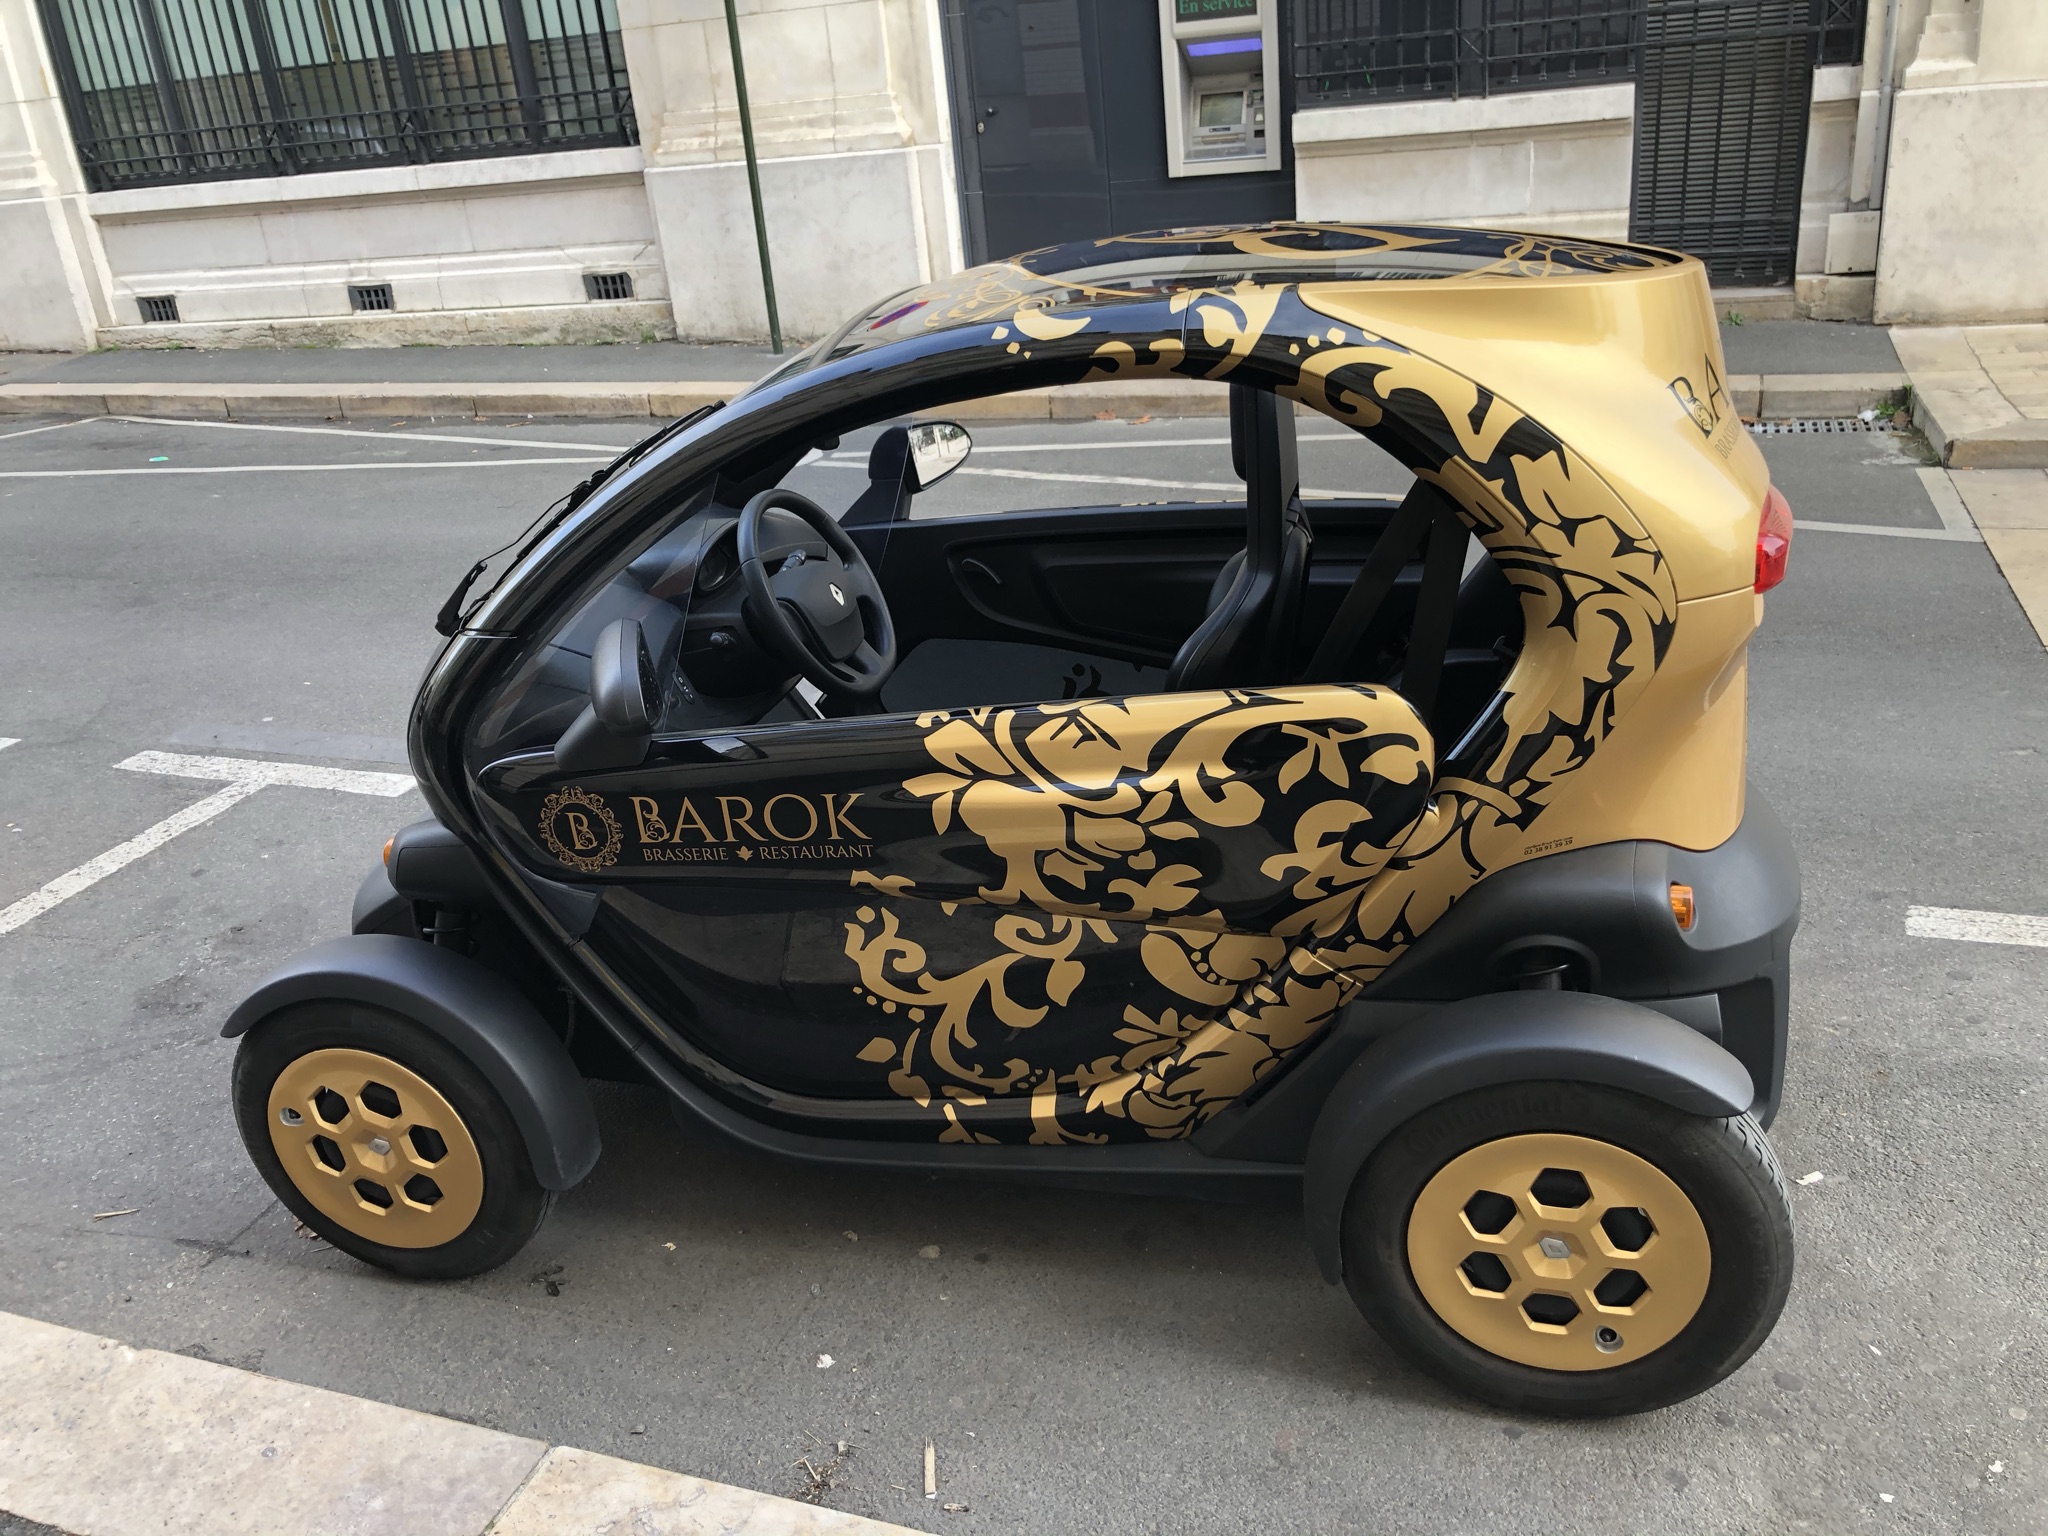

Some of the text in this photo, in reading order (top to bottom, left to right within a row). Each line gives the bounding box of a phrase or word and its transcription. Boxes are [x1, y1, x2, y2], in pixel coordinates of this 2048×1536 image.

[1180, 0, 1253, 14] En service
[565, 812, 598, 850] B
[628, 793, 873, 843] BAROK
[642, 844, 874, 862] BRASSERIE RESTAURANT
